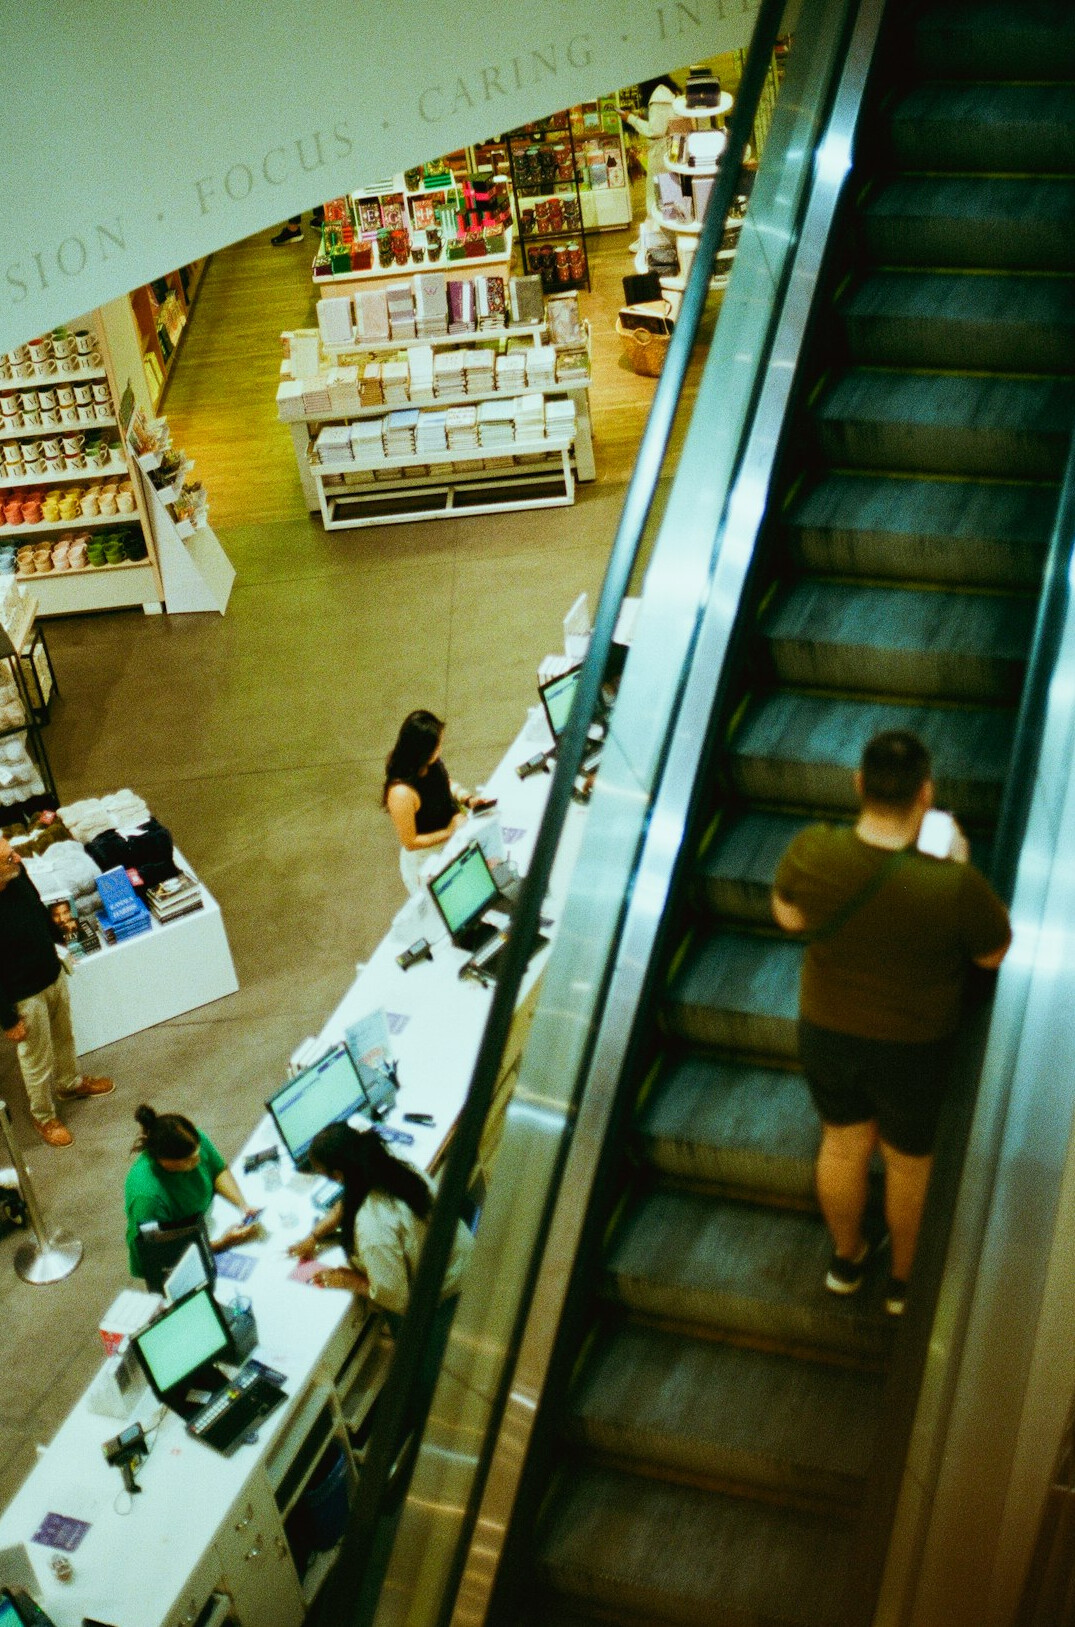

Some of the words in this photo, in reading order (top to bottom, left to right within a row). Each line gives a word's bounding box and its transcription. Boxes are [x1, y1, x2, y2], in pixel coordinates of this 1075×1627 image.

[195, 121, 354, 215] FOCUS
[417, 34, 593, 123] CARING
[57, 345, 66, 354] G
[80, 340, 89, 349] H
[62, 362, 71, 371] G
[63, 391, 72, 401] O
[81, 390, 89, 399] P
[97, 386, 109, 397] Q
[28, 396, 38, 406] M
[45, 394, 55, 403] N
[67, 410, 76, 420] O
[85, 409, 93, 419] P
[98, 407, 109, 417] Q
[47, 443, 57, 453] W
[52, 461, 61, 471] W
